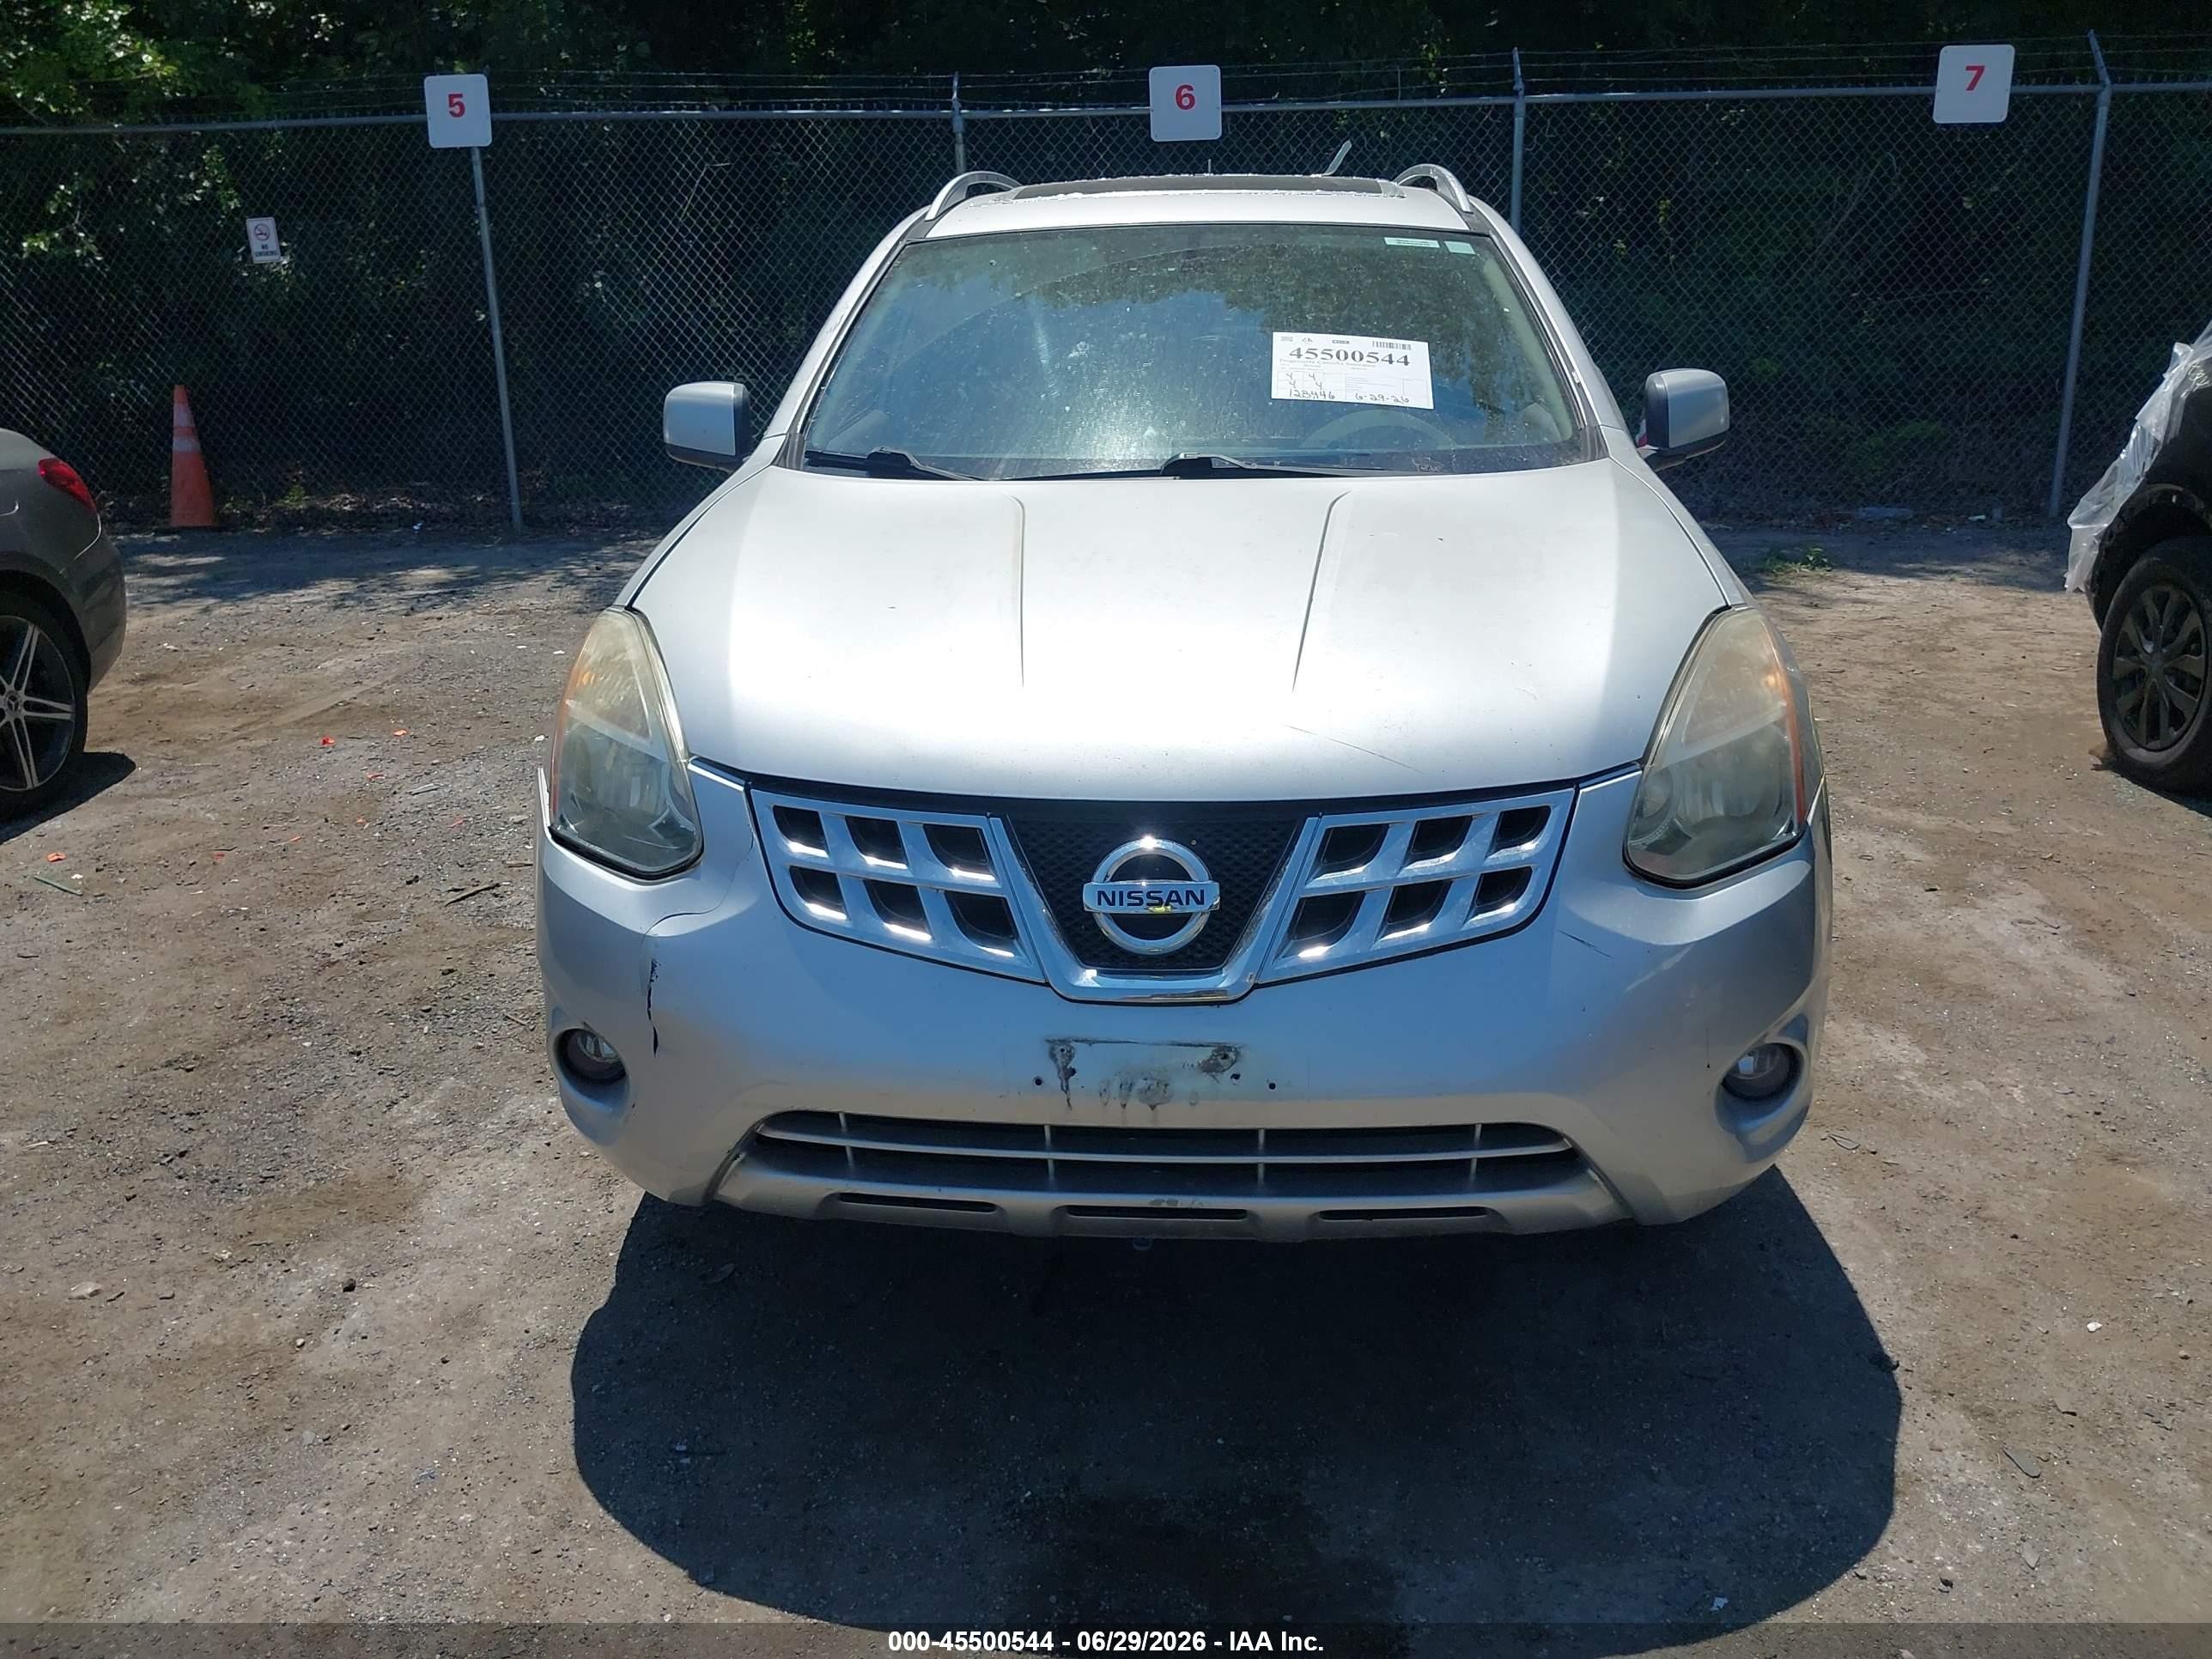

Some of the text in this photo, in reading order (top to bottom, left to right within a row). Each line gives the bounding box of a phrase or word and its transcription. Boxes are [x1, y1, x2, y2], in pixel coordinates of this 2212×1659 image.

[1965, 65, 1985, 91] 7
[447, 93, 466, 118] 5
[1175, 84, 1196, 111] 6
[1290, 347, 1410, 366] 45500544
[1355, 392, 1410, 404] 6-29-26
[1097, 890, 1205, 907] NISSAN
